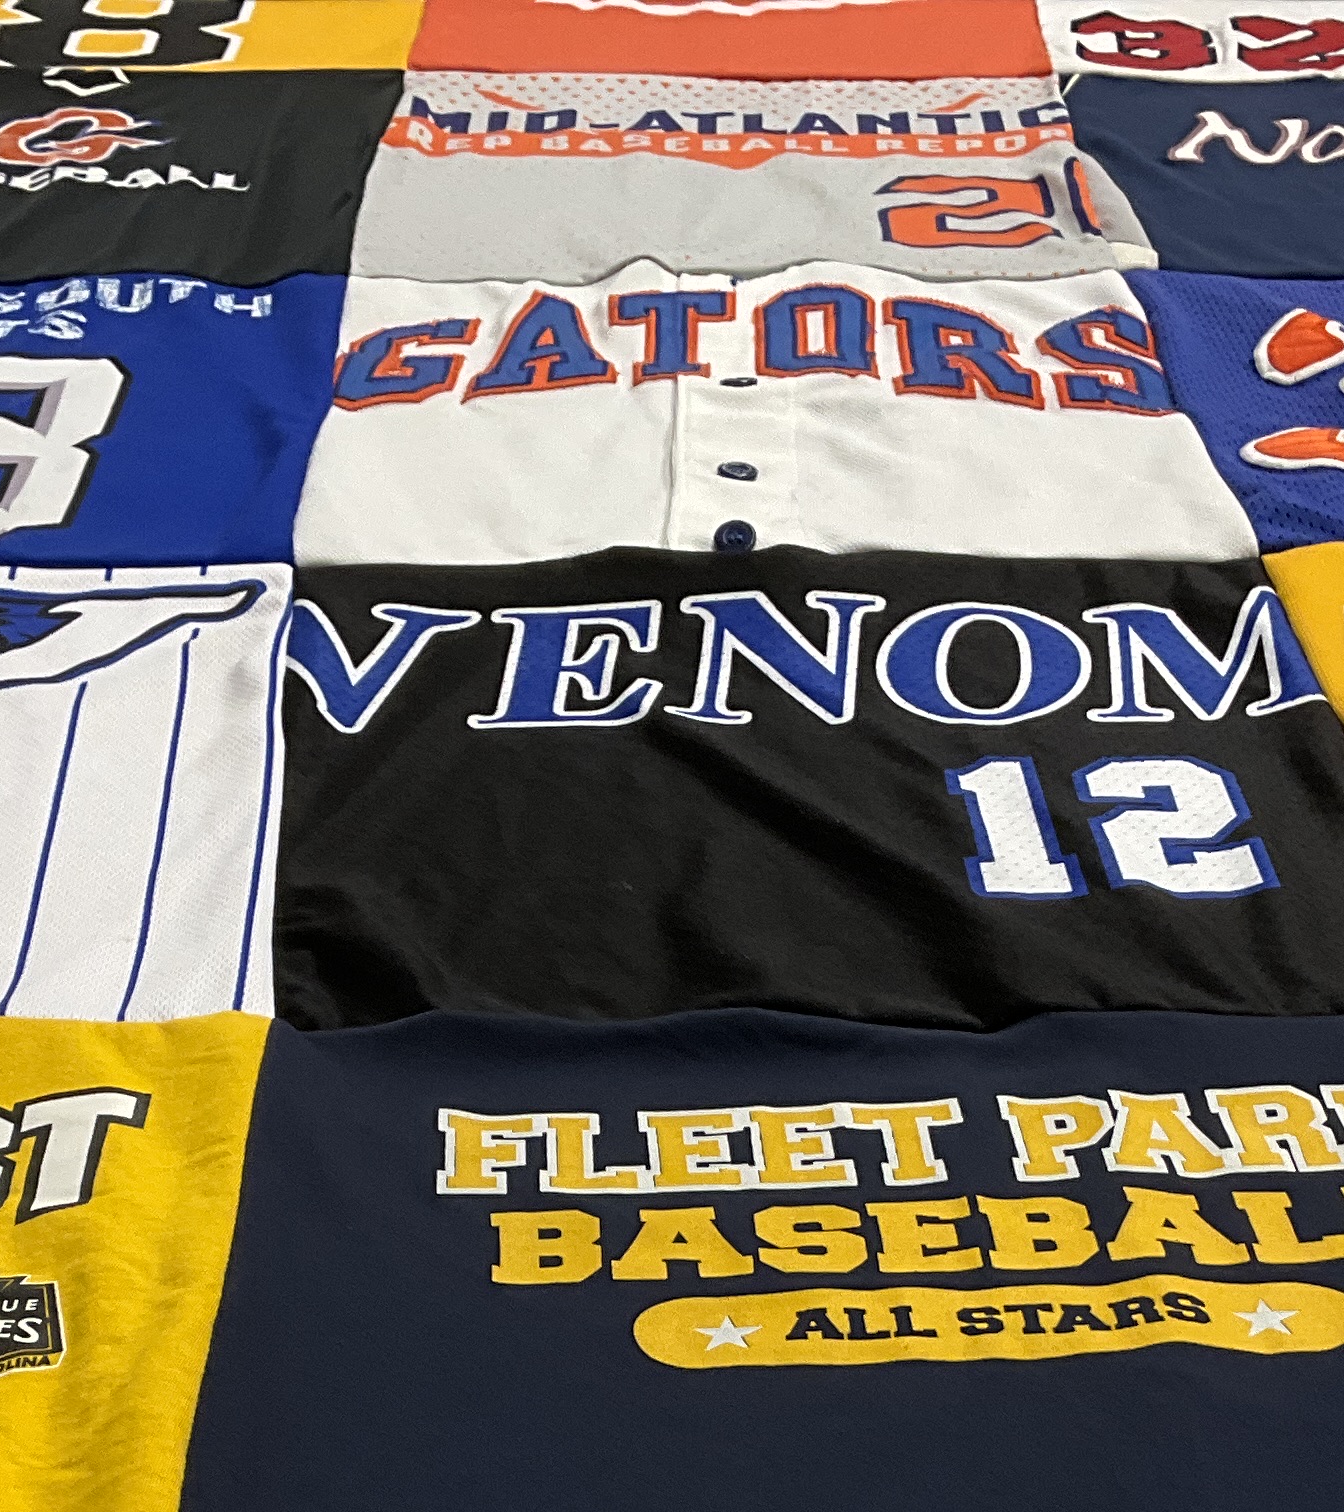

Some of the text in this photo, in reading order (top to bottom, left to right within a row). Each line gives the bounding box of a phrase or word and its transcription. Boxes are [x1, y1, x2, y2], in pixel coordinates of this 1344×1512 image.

[389, 119, 513, 151] REP
[540, 133, 850, 154] BASEBALL
[873, 155, 1104, 249] 2
[332, 283, 1177, 417] GATORS
[284, 584, 1330, 734] VENOM
[945, 754, 1281, 901] 12
[434, 1096, 964, 1196] FLEET
[781, 1291, 1212, 1343] ALL STARS
